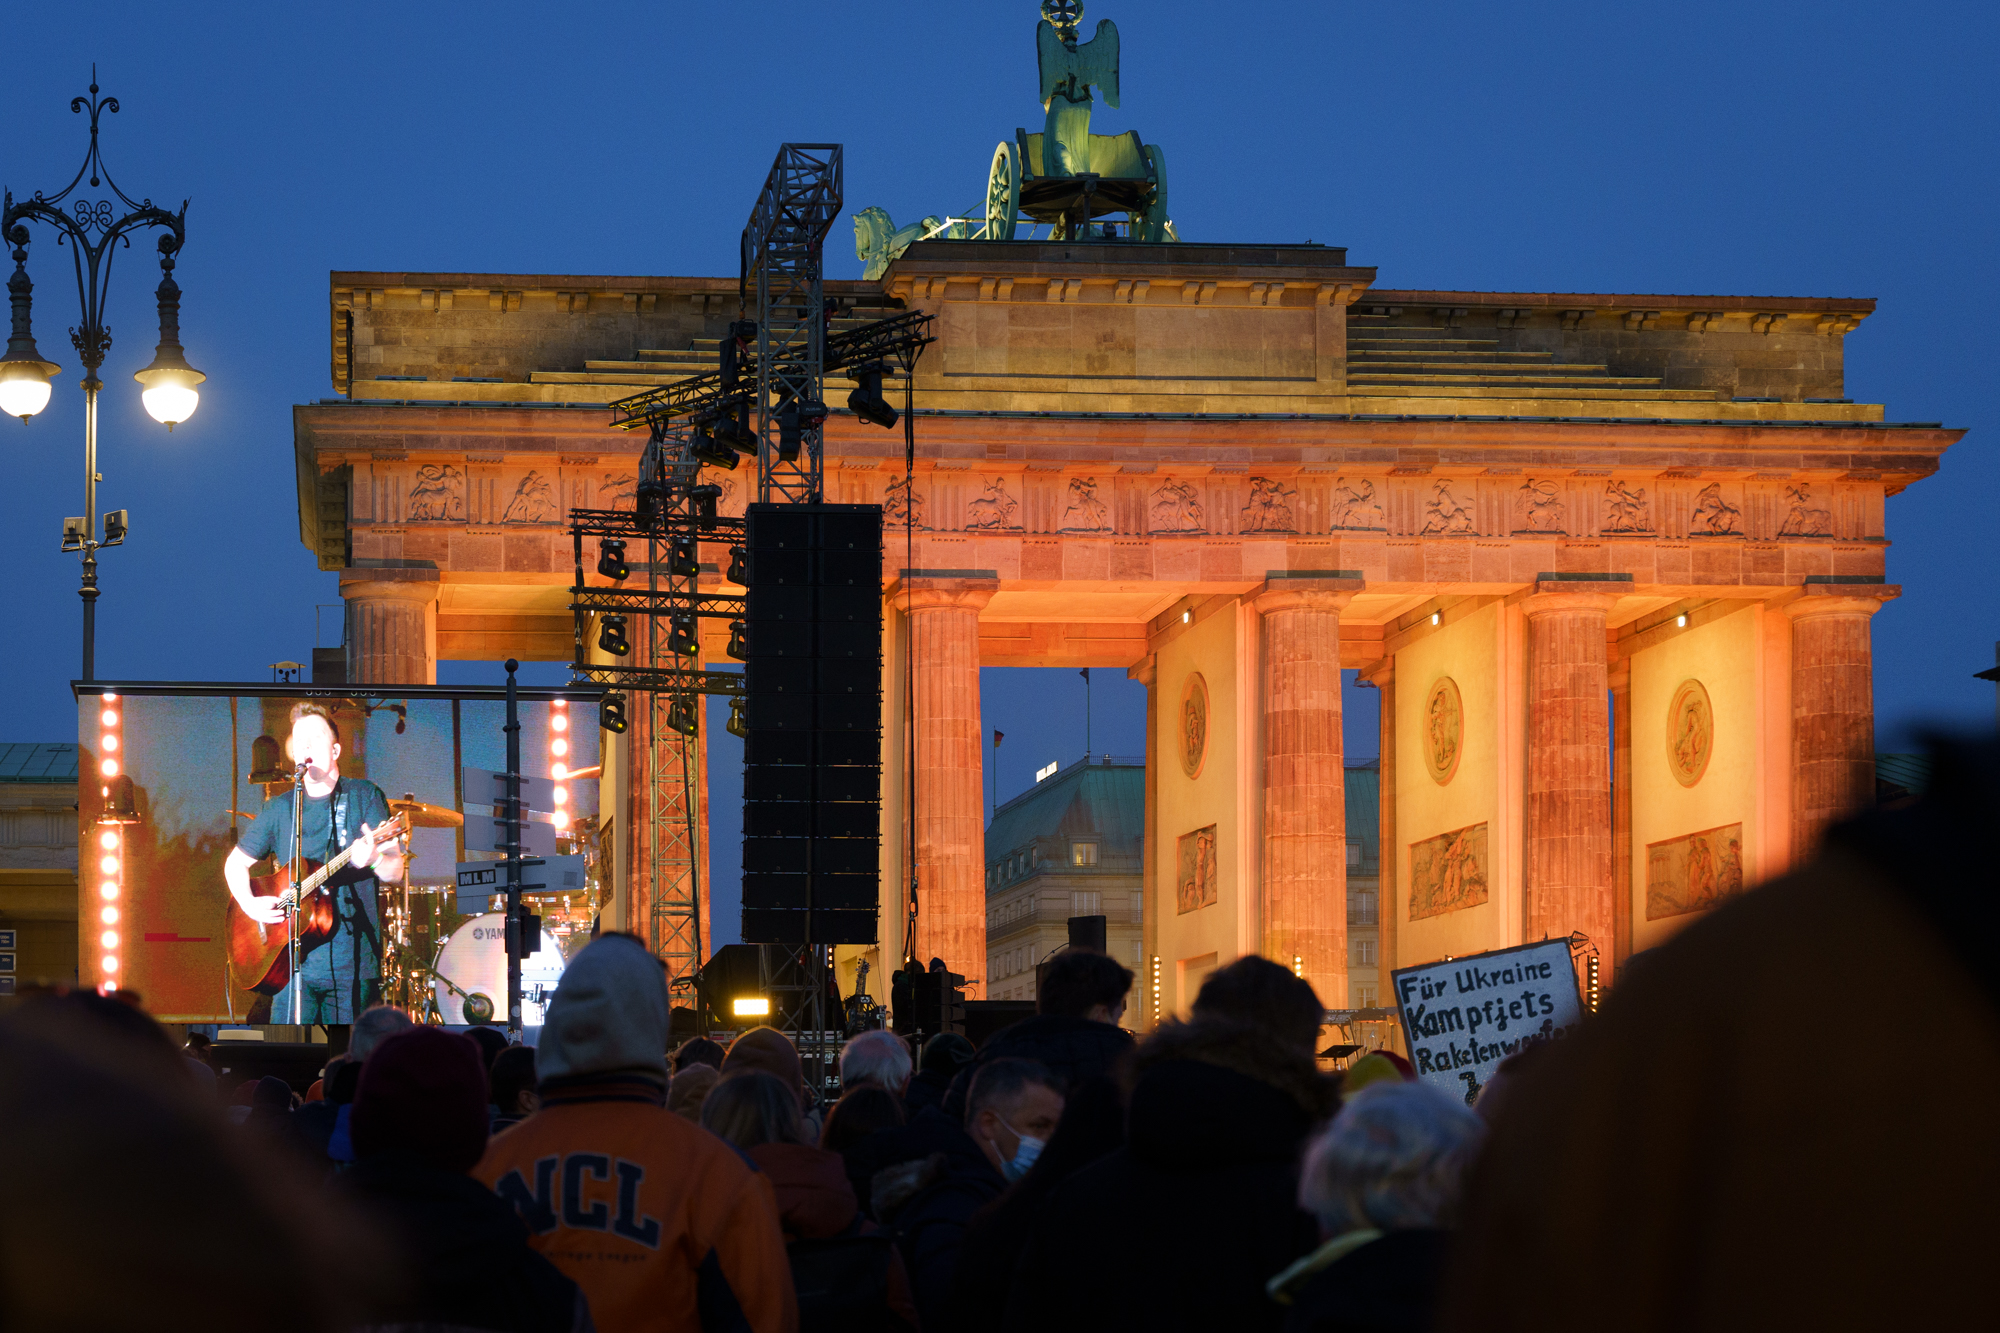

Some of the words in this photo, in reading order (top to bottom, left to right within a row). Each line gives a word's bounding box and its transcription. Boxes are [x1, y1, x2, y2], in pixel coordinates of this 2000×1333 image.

[460, 871, 495, 886] MLM
[1399, 976, 1447, 1004] Für
[1455, 961, 1552, 994] Ukraine
[1406, 990, 1554, 1041] Kampfjets
[494, 1151, 662, 1250] NCL
